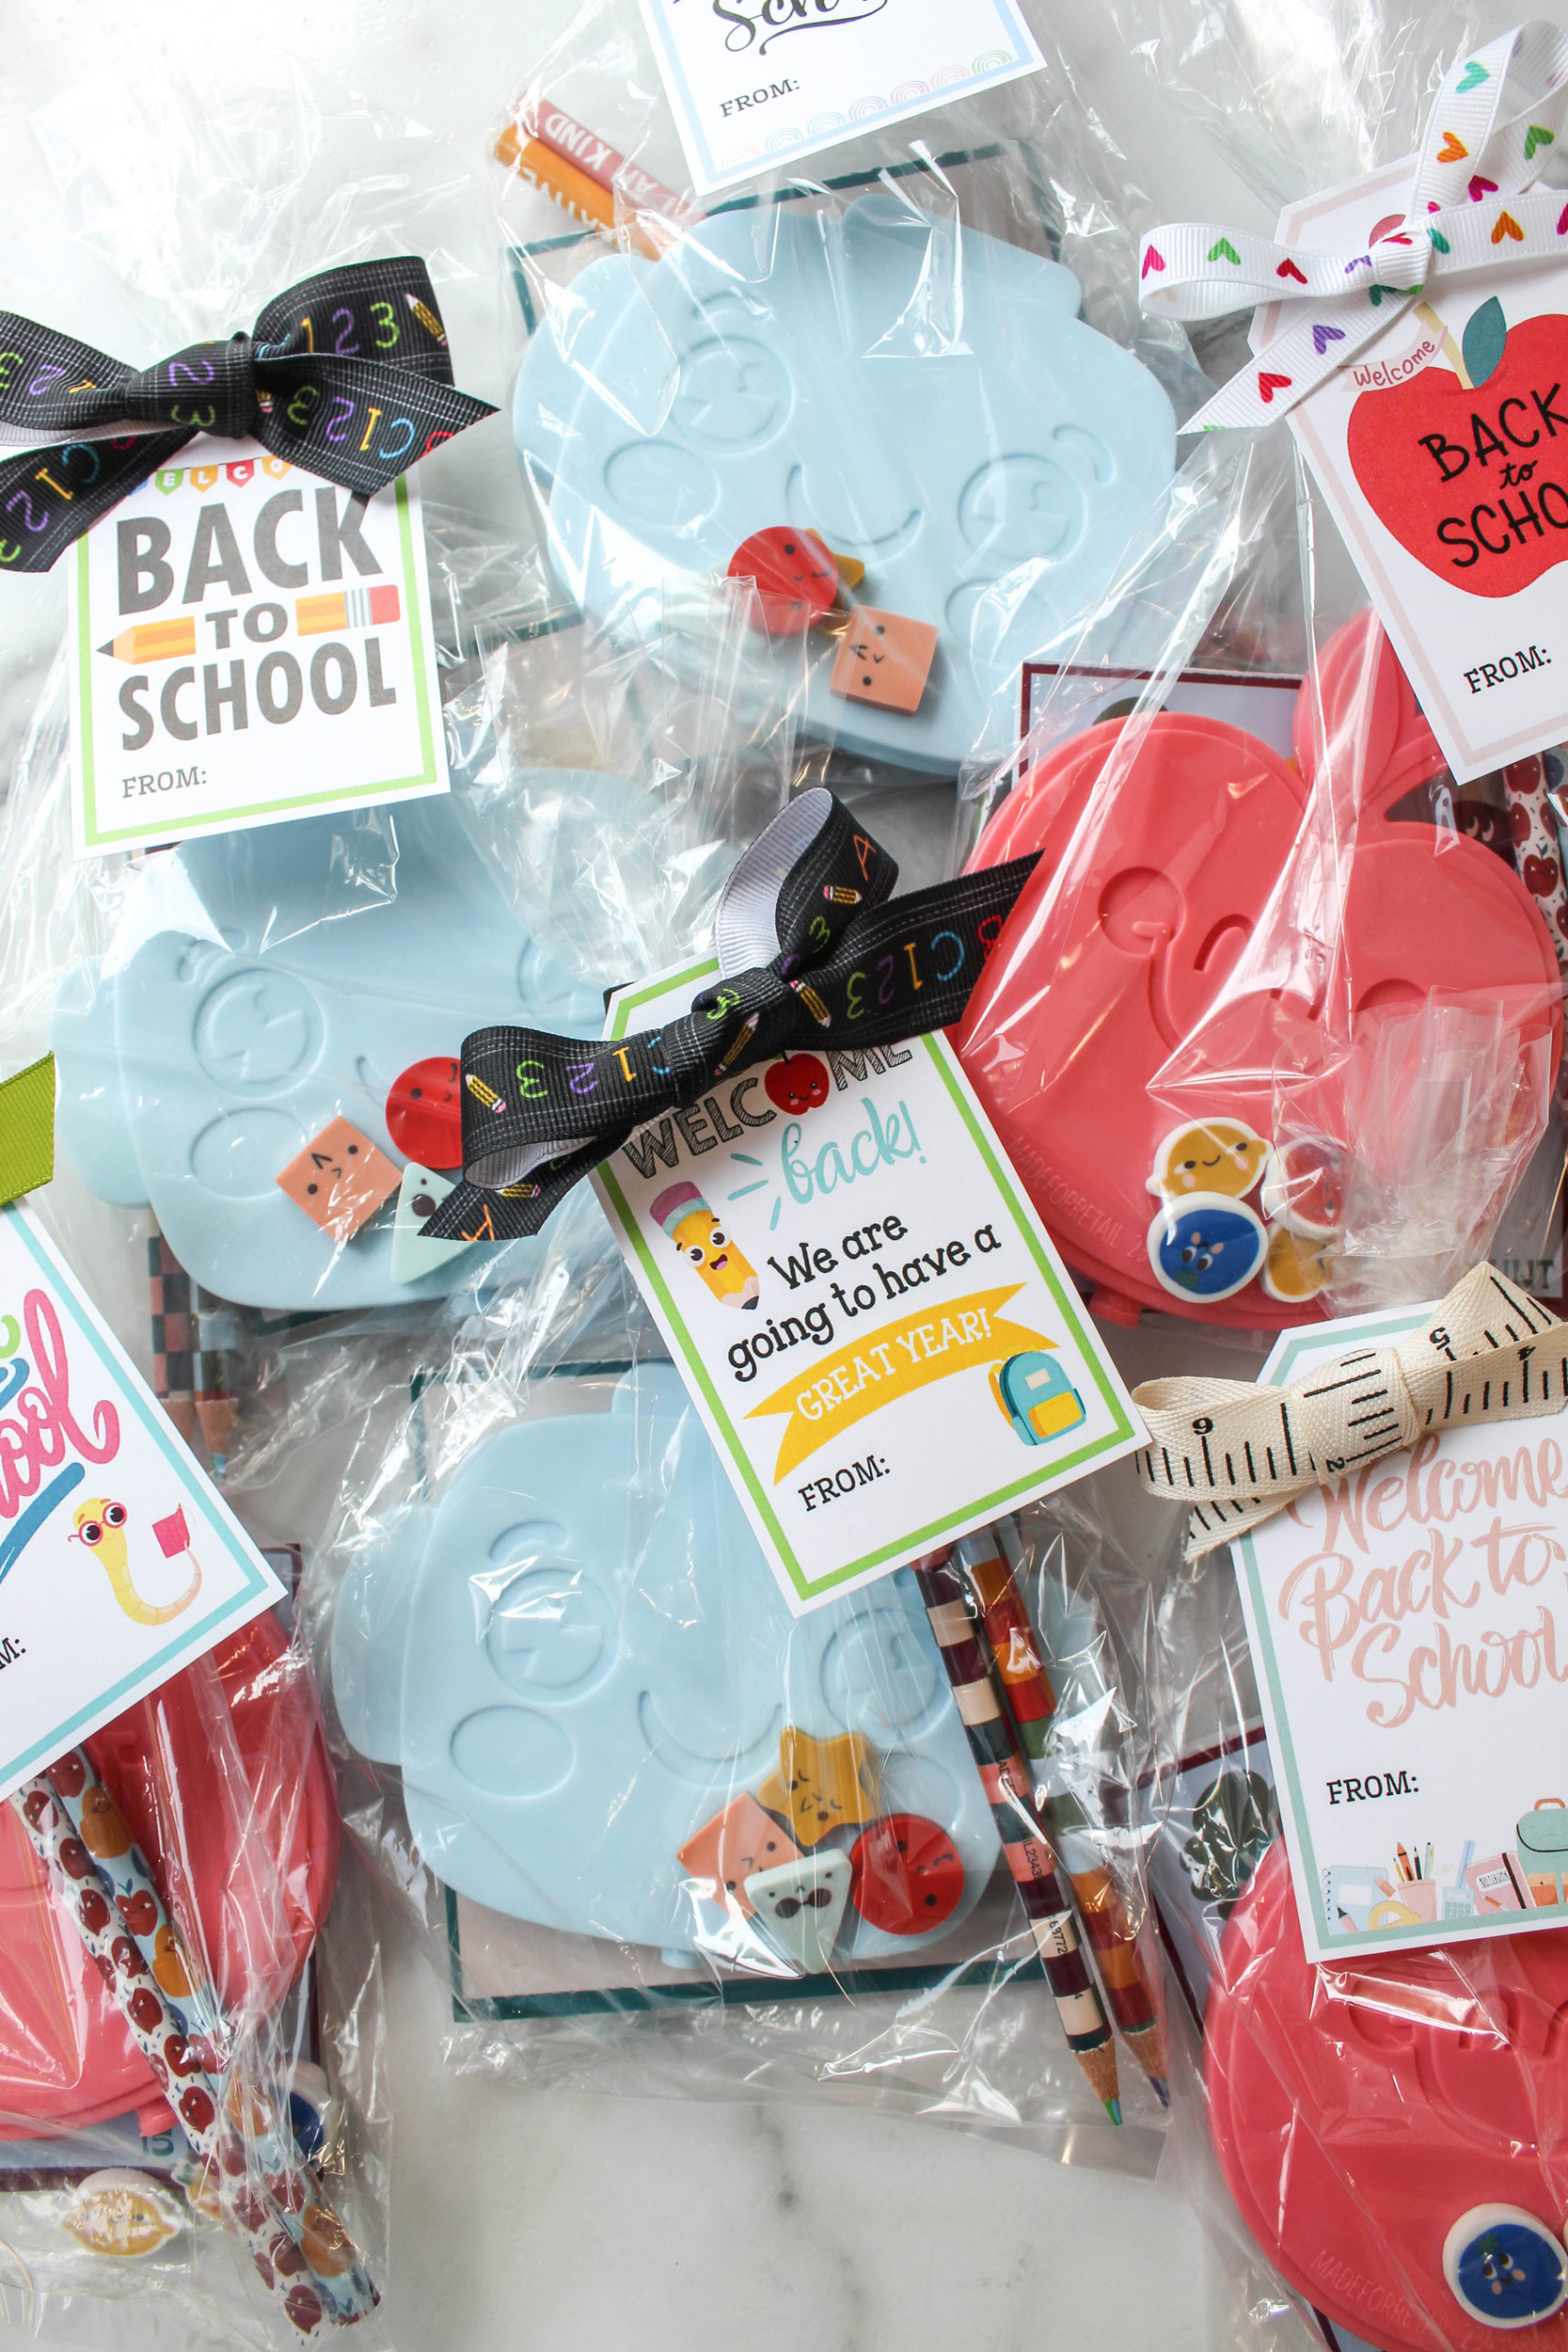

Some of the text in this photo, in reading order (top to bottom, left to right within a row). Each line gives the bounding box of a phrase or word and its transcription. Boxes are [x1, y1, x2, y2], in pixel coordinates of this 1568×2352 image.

[720, 78, 801, 118] FROM:
[545, 113, 612, 171] KIND
[1354, 341, 1435, 387] Welcome
[1418, 383, 1568, 484] BACK
[1499, 460, 1539, 490] to
[116, 486, 384, 615] BACK
[204, 601, 289, 651] TO
[117, 636, 398, 752] SCHOOL
[1463, 644, 1553, 696] FROM:
[121, 766, 208, 799] FROM:
[782, 1097, 927, 1205] back!
[768, 1216, 909, 1290] We are
[727, 1224, 1003, 1383] going to have a
[796, 1308, 992, 1422] GREAT YEAR!
[797, 1454, 892, 1512] FROM:
[1286, 1433, 1568, 1555] Welcome
[1278, 1516, 1566, 1683] Back to
[1352, 1605, 1568, 1729] School
[1325, 1770, 1420, 1806] FROM:
